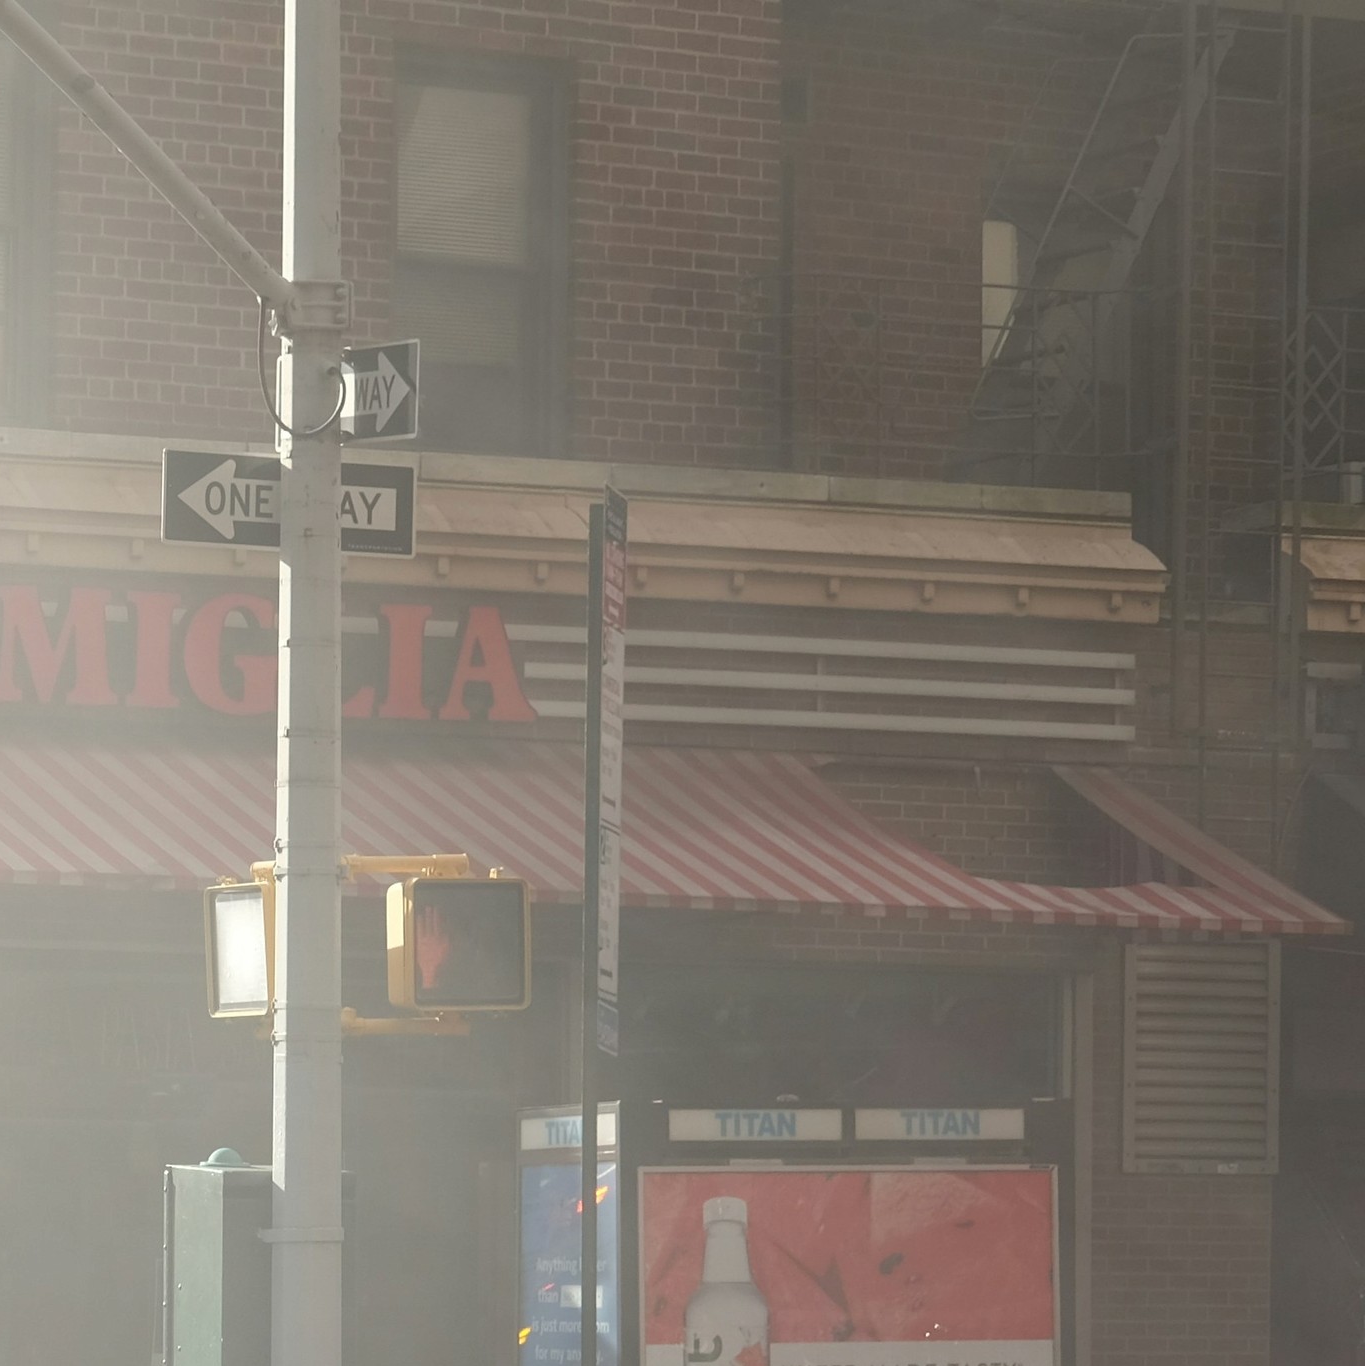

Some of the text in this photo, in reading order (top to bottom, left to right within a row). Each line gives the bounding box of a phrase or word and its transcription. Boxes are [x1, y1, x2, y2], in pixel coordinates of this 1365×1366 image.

[204, 481, 382, 526] ONE AY
[545, 1119, 583, 1146] TITA
[714, 1112, 797, 1137] TITAN
[900, 1110, 980, 1137] TITAN
[535, 1256, 578, 1276] Anything
[537, 1290, 559, 1304] than
[540, 1316, 557, 1336] just
[558, 1320, 582, 1333] more
[535, 1344, 548, 1360] for
[550, 1350, 564, 1365] my
